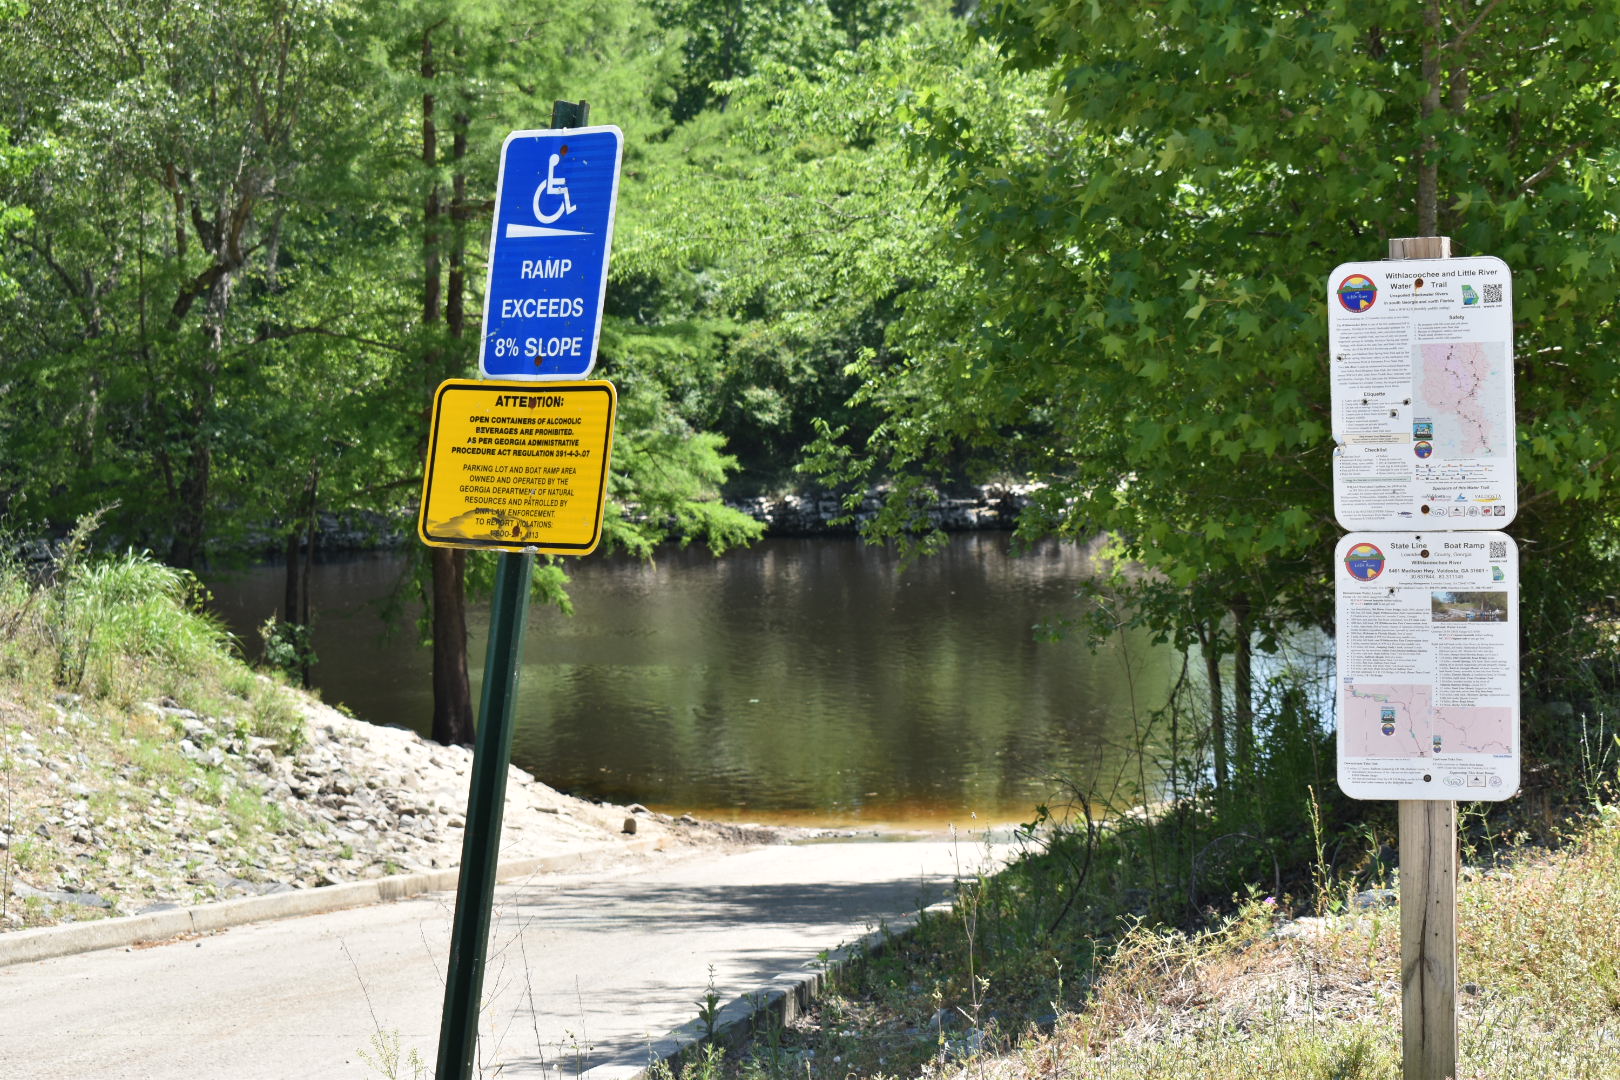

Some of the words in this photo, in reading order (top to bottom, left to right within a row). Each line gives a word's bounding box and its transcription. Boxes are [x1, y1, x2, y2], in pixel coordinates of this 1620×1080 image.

[521, 259, 572, 279] RAMP
[502, 298, 584, 318] EXCEEDS
[495, 337, 518, 357] 8%
[524, 337, 582, 357] SLOPE
[495, 395, 564, 408] ATTENTION:
[452, 447, 496, 455] PROCEDURE
[463, 464, 493, 472] PARKING
[460, 485, 490, 493] GEORGIA
[492, 487, 537, 495] DEPARTMENT
[464, 496, 506, 504] RESOURCES
[508, 509, 556, 518] ENFORCEMENT.
